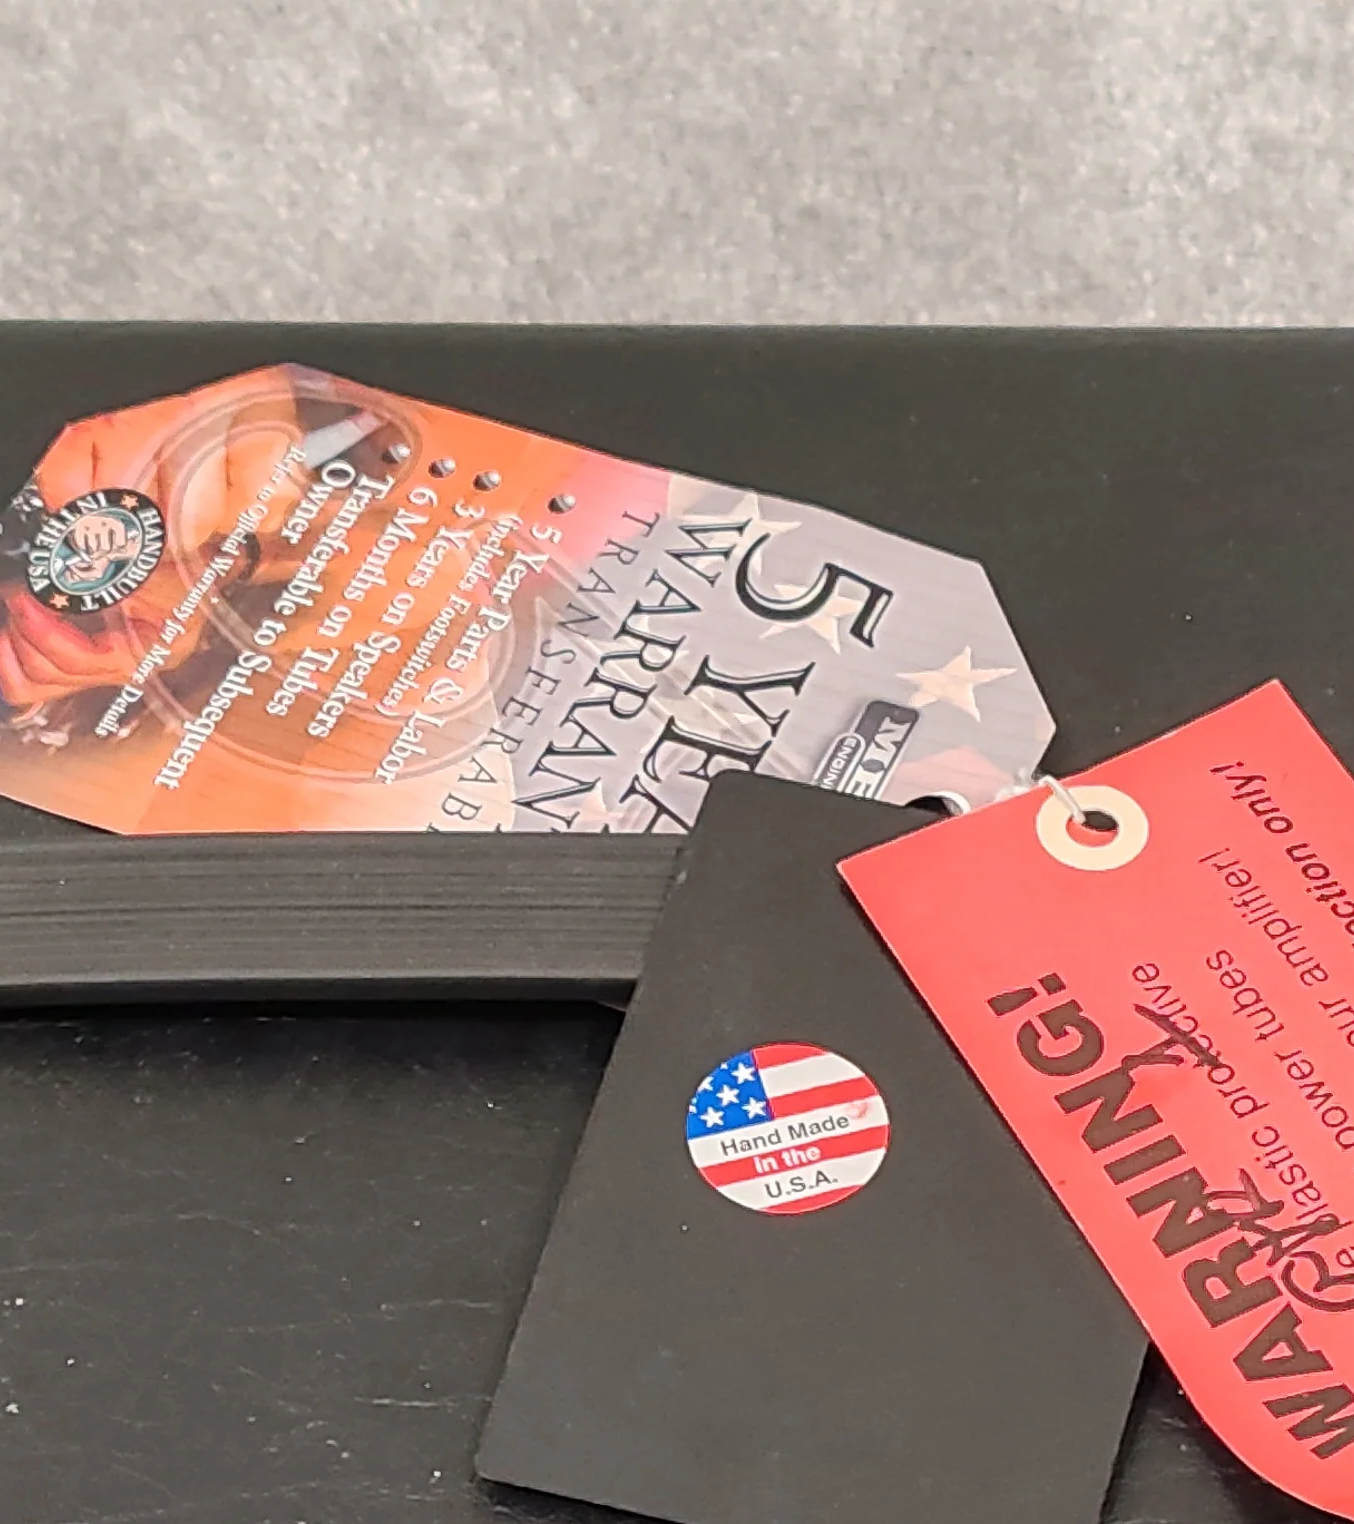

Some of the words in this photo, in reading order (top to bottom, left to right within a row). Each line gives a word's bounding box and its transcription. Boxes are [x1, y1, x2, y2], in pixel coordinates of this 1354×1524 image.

[34, 508, 80, 549] THE
[77, 491, 107, 515] IN
[281, 460, 356, 544] Owner
[408, 487, 438, 508] 6
[453, 503, 485, 519] 3
[81, 507, 164, 611] HANDBUILT
[274, 473, 394, 616] Transferable
[344, 507, 429, 602] Months
[406, 525, 475, 588] Years
[458, 516, 523, 591] (Includes
[531, 524, 563, 544] 5
[27, 548, 52, 592] USA
[492, 550, 550, 604] Year
[735, 532, 894, 648] 5
[159, 618, 186, 645] for
[253, 618, 286, 645] to
[318, 605, 352, 637] on
[382, 592, 415, 625] on
[446, 605, 512, 671] Parts
[133, 643, 172, 683] More
[265, 647, 340, 716] Tubes
[307, 631, 401, 737] Speakers
[375, 594, 472, 716] Footswitches)
[426, 511, 660, 833] TRANSFERAB
[512, 518, 752, 833] WARRAN
[94, 684, 145, 739] Details
[153, 649, 272, 790] Subsequent
[423, 677, 464, 704] &
[375, 710, 446, 784] Labor
[618, 655, 816, 834] YEA
[845, 716, 912, 799] ME
[1210, 761, 1293, 833] only!
[1198, 848, 1329, 986] amplifier!
[1206, 949, 1284, 1041] tubes
[720, 1128, 782, 1156] Hand
[788, 1116, 849, 1143] Made
[781, 1146, 821, 1167] the
[765, 1170, 838, 1199] U.S.A.
[1251, 1126, 1353, 1233] plastic
